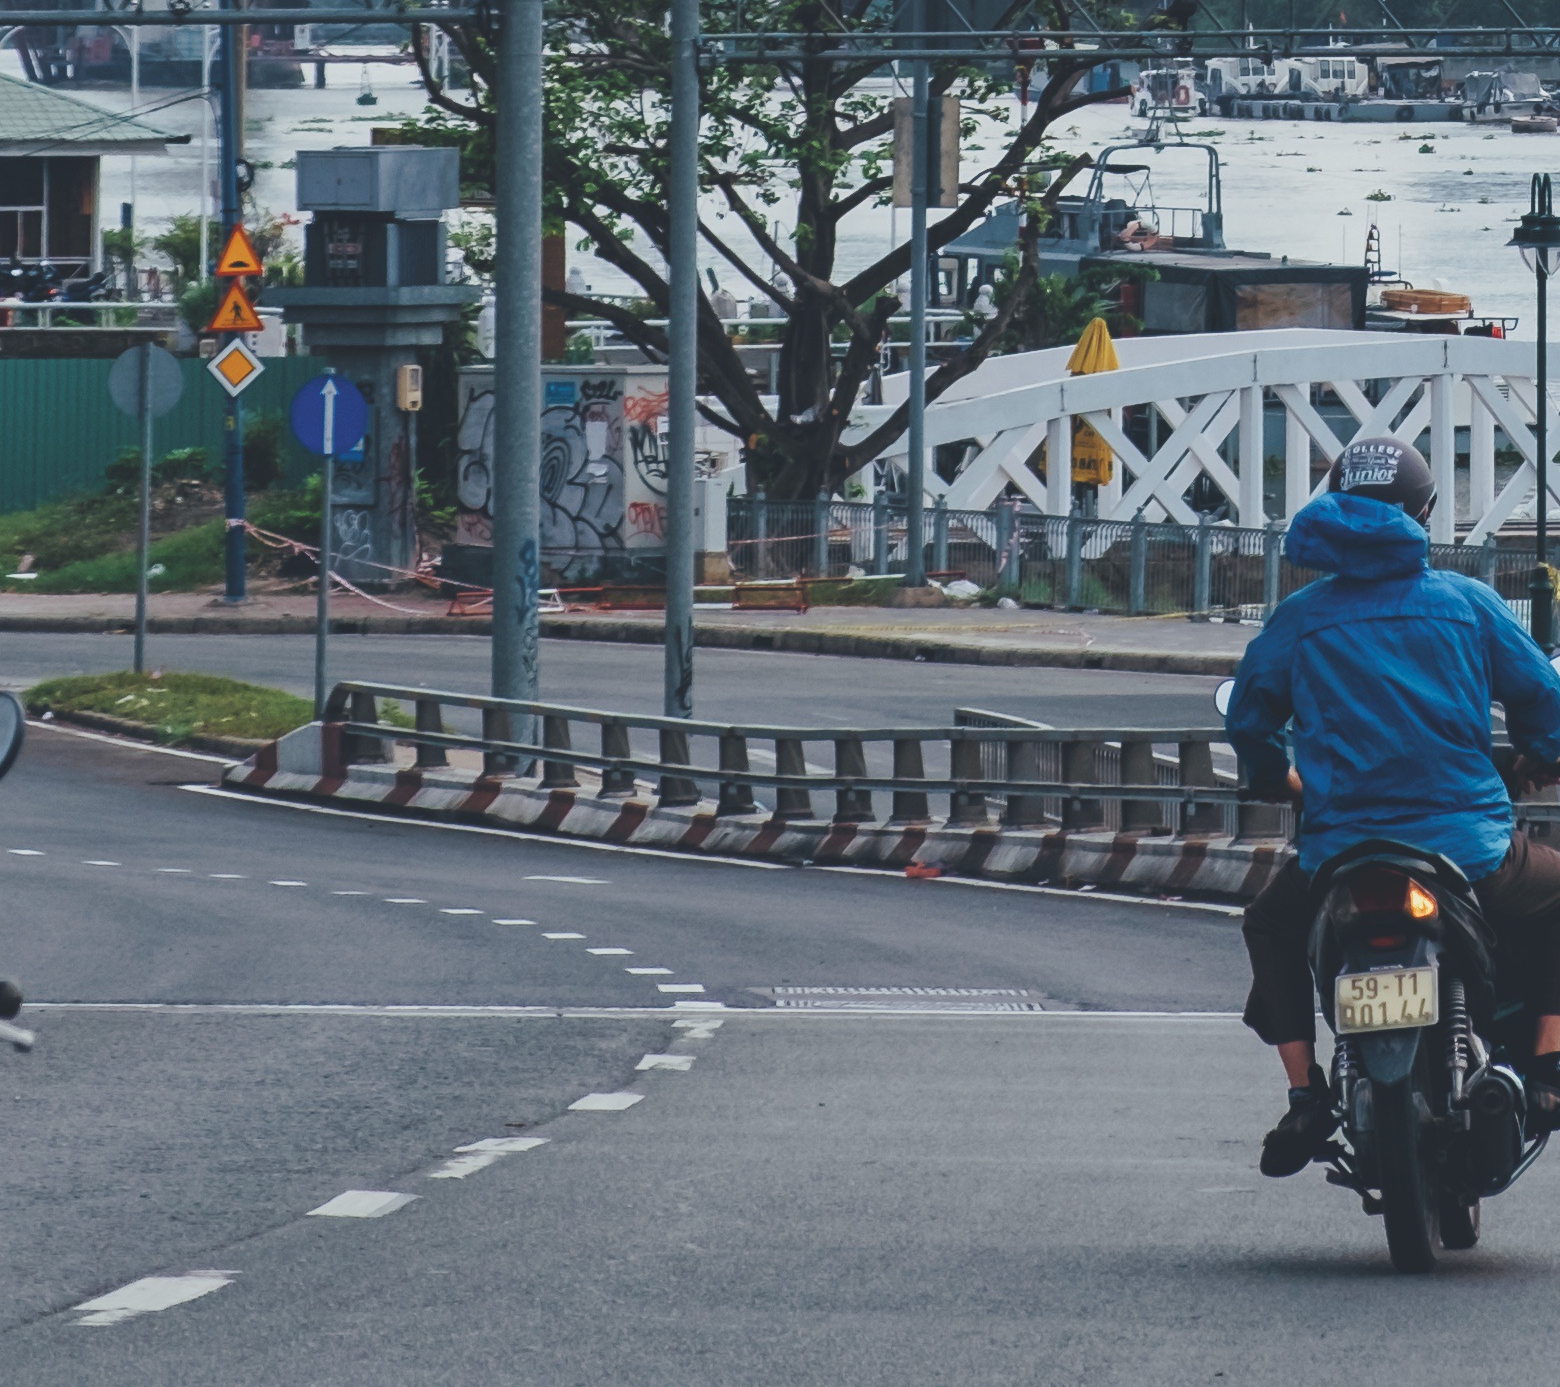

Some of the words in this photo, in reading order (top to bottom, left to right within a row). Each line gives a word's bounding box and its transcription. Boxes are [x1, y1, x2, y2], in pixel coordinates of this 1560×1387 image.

[1344, 444, 1403, 460] COLLEGE
[1341, 467, 1398, 488] Junior
[1351, 972, 1418, 1001] 59-T1
